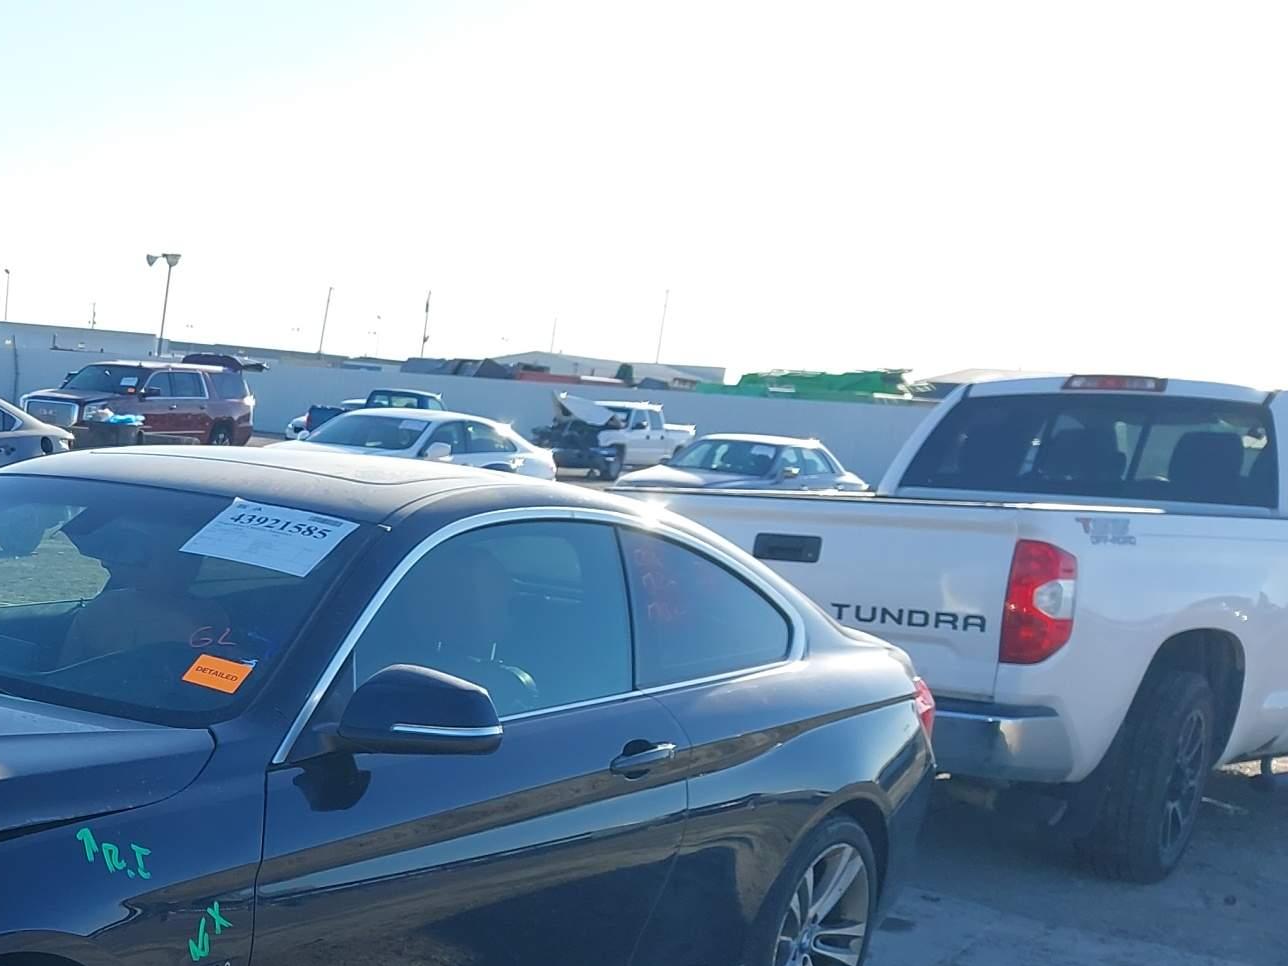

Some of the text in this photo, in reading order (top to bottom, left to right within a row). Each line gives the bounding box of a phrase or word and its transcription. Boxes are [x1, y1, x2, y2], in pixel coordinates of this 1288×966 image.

[229, 512, 333, 540] 43921585
[831, 602, 987, 633] TUNDRA
[195, 664, 239, 683] DETAILED
